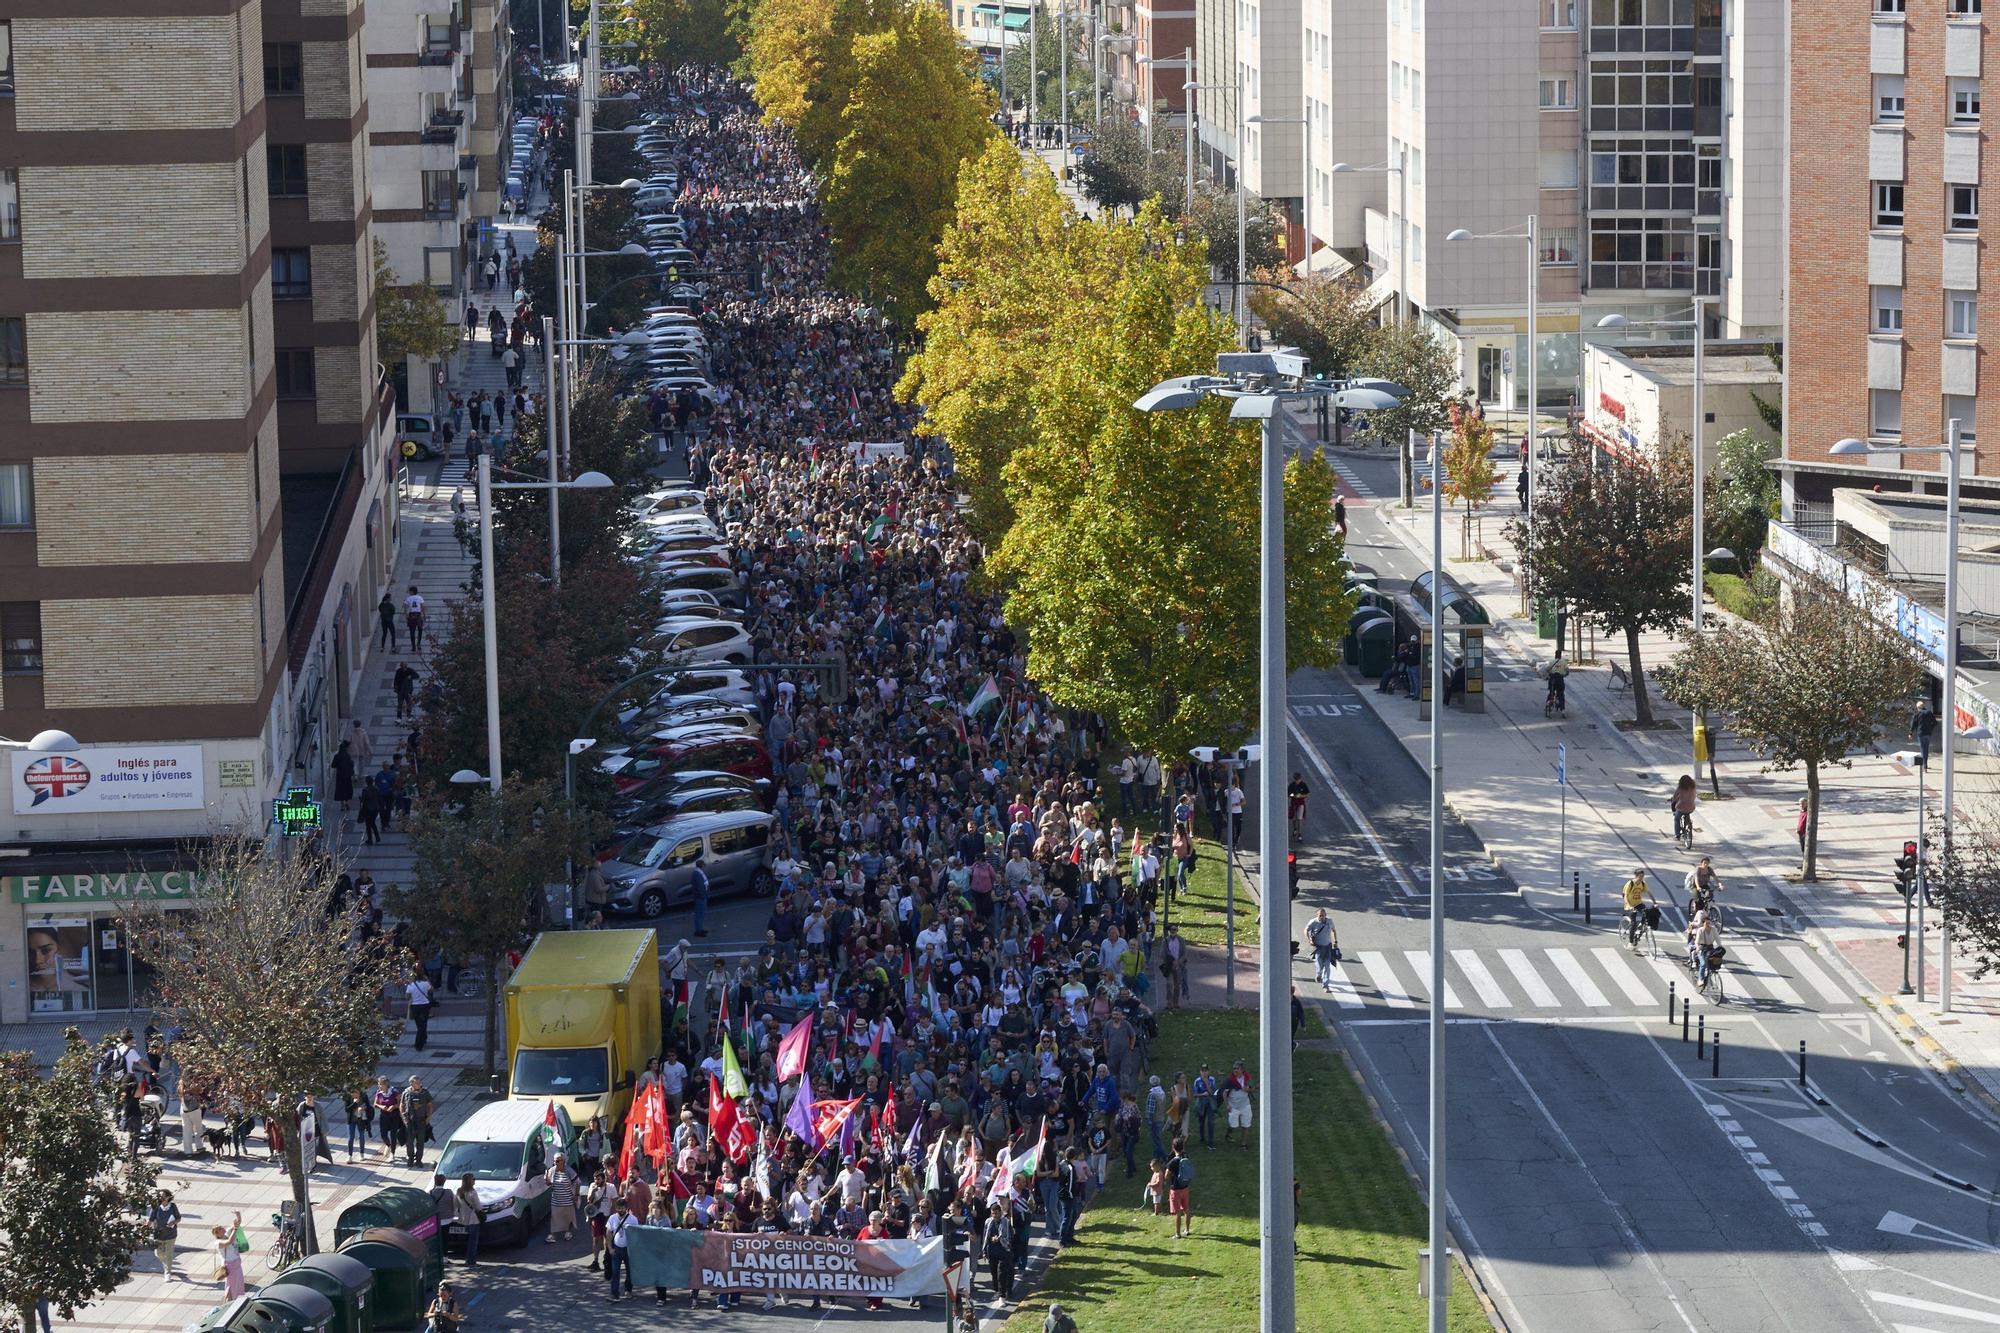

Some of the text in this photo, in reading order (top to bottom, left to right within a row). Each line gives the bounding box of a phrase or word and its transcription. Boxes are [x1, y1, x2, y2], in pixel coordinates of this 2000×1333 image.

[1292, 704, 1362, 716] BUS
[117, 757, 177, 770] Inglés para
[26, 773, 87, 783] thefourcorners.es
[100, 770, 192, 783] adultos y jóvenes
[732, 1238, 855, 1255] ¡STOP GENOCIDIO!
[730, 1251, 859, 1272] LANGILEOK
[702, 1268, 895, 1292] PALESTINAREKIN!
